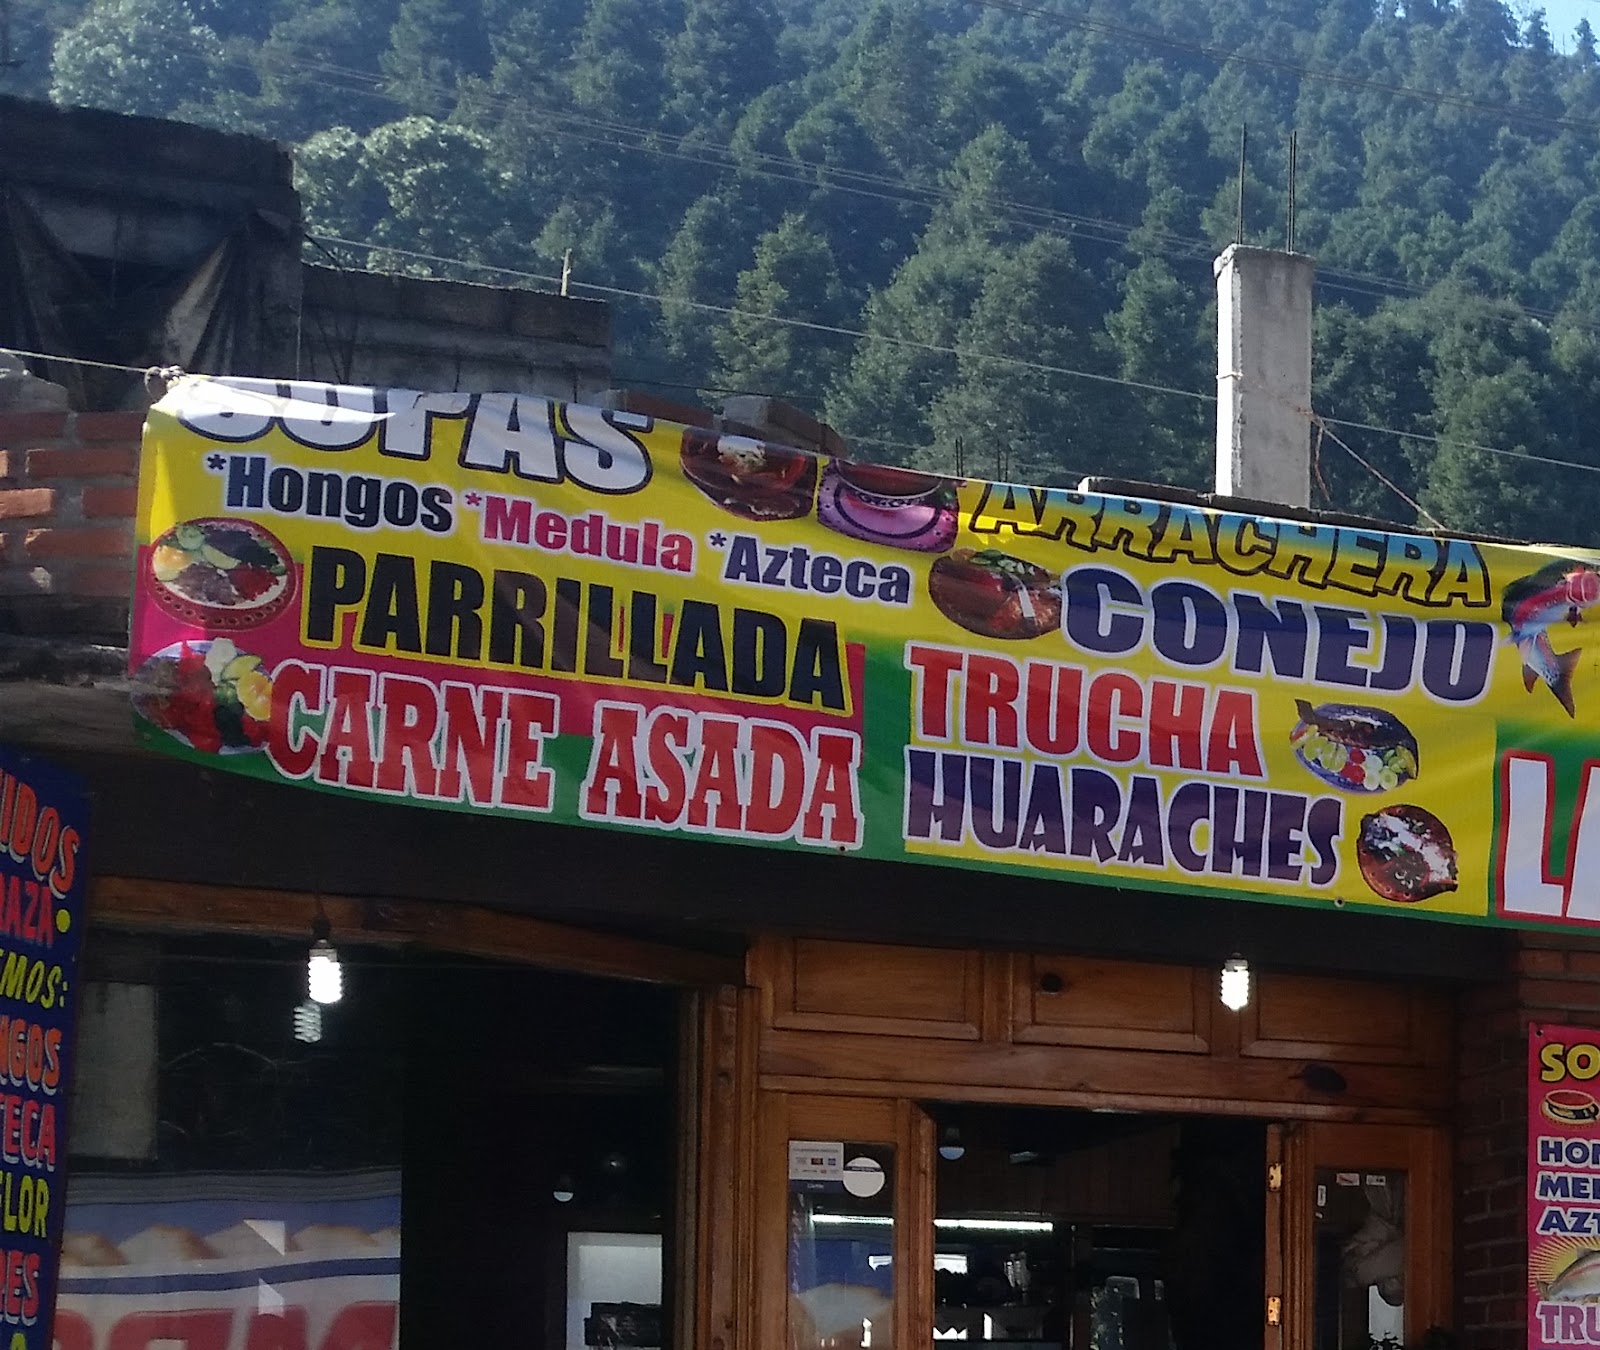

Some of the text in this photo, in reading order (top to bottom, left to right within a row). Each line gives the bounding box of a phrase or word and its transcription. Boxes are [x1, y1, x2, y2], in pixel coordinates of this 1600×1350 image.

[969, 481, 1493, 607] ARRACHERA
[301, 545, 852, 716] PARRILLADA
[1060, 564, 1499, 706] CONEJO
[264, 659, 864, 851] CARNE ASADA
[906, 641, 1266, 781] TRUCHA
[905, 749, 1345, 887] HUARACHES
